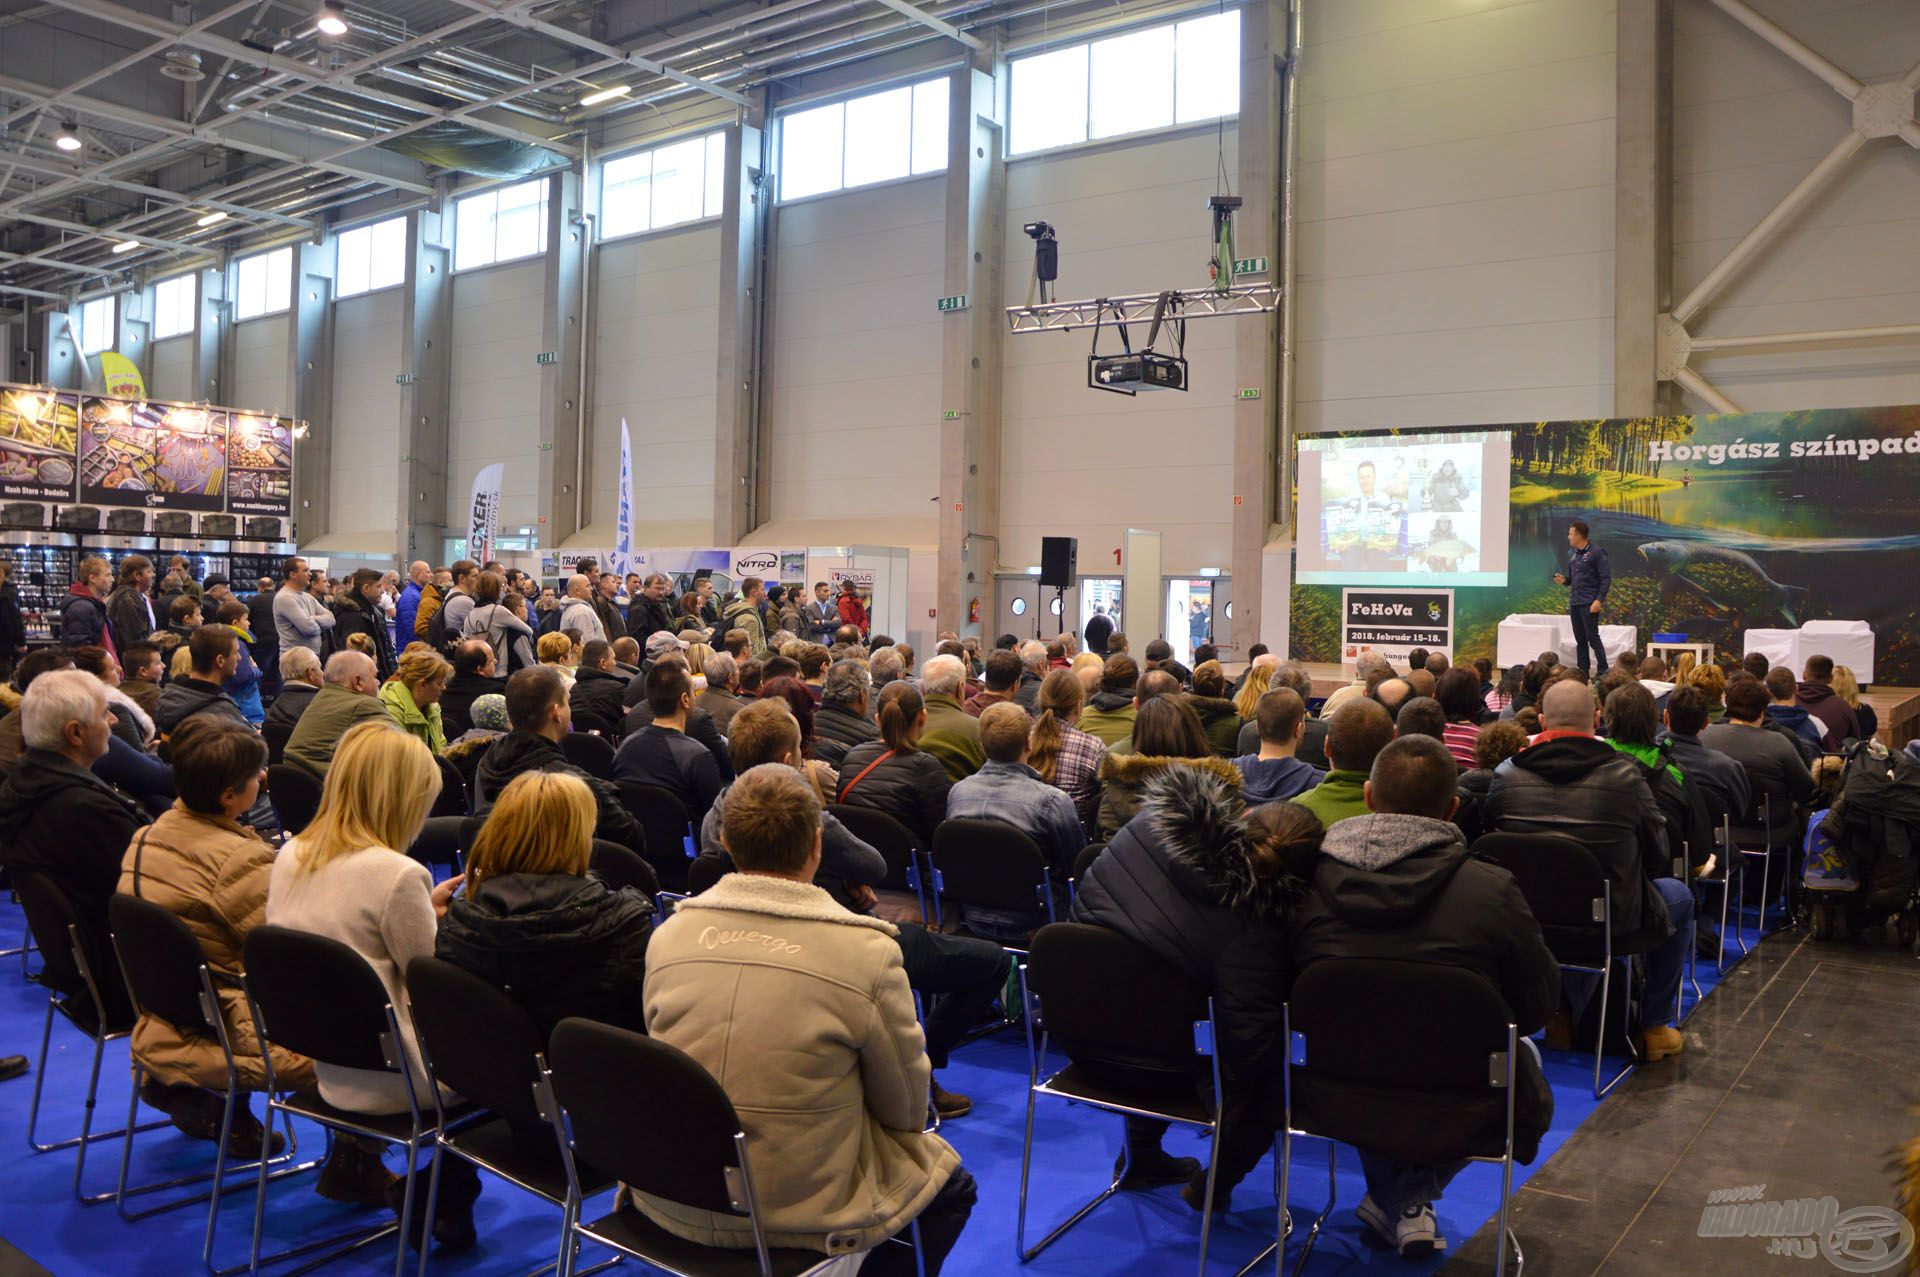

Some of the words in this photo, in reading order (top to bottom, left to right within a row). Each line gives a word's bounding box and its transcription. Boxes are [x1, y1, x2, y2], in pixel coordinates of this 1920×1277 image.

[1649, 438, 1780, 465] Horgász
[1790, 431, 1920, 461] színpad
[470, 491, 488, 567] ACKER
[1113, 548, 1121, 565] 1
[1351, 602, 1413, 616] FeHoVa
[1351, 632, 1375, 641] 2018.
[1376, 632, 1412, 642] február
[1384, 653, 1411, 661] hunge
